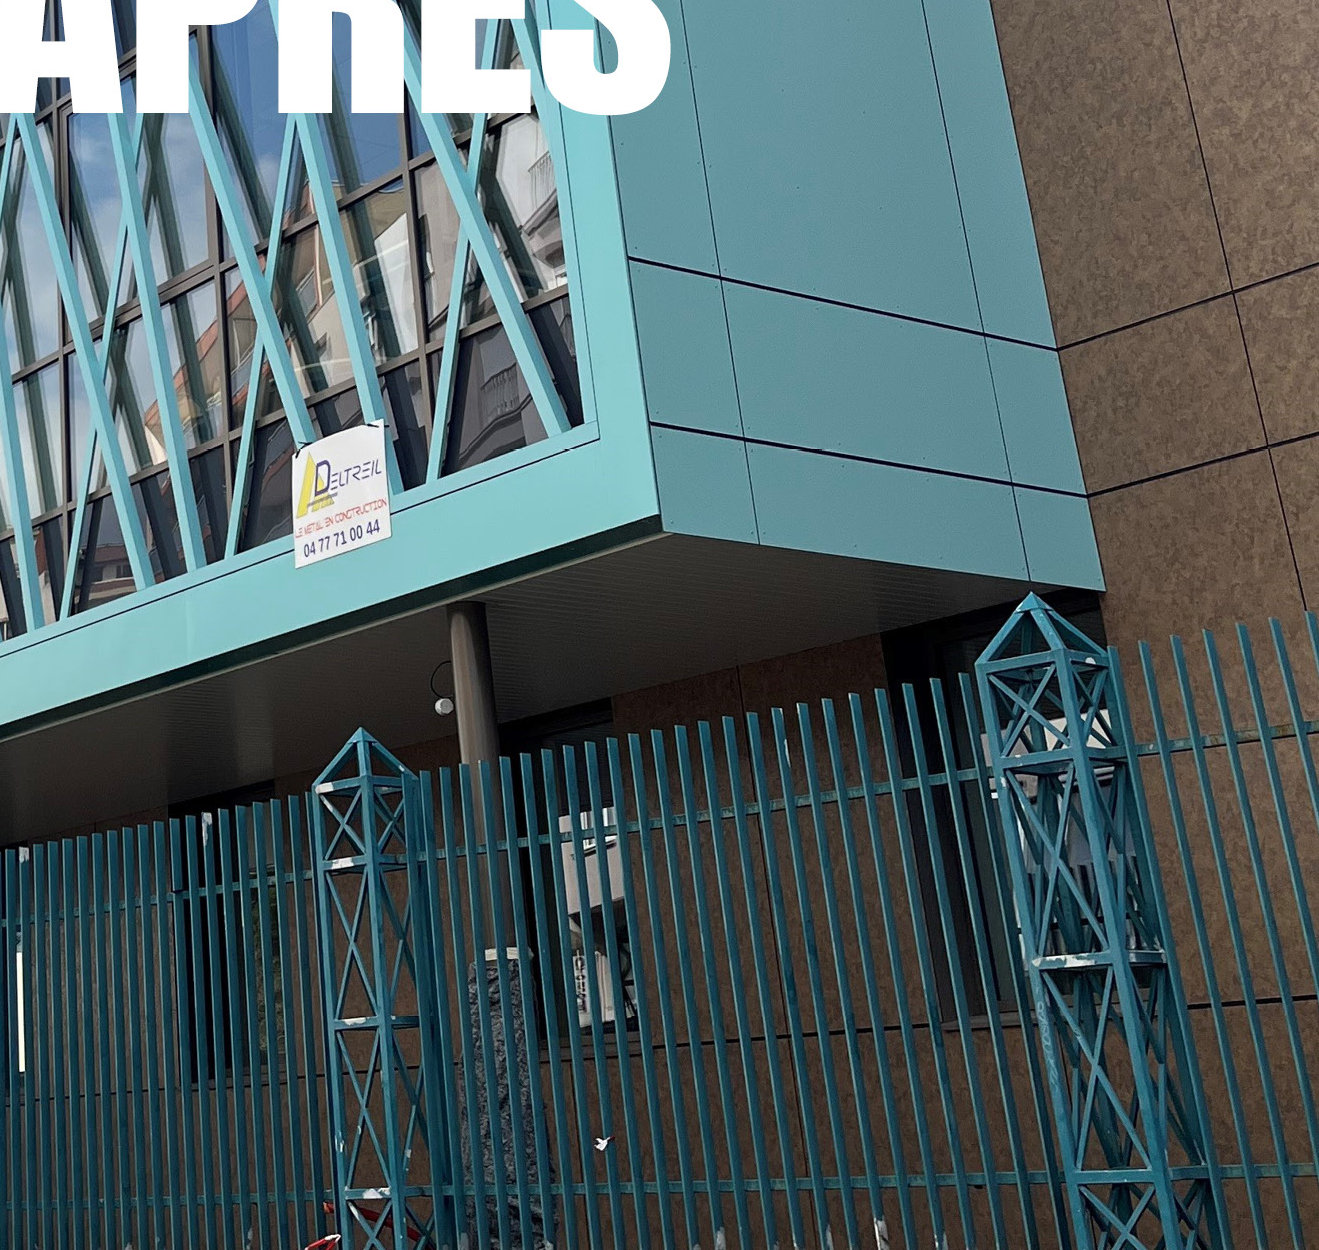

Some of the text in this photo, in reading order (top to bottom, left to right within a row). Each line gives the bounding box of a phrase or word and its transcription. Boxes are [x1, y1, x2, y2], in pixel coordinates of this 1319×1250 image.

[304, 519, 380, 557] 04 77 71 00 44
